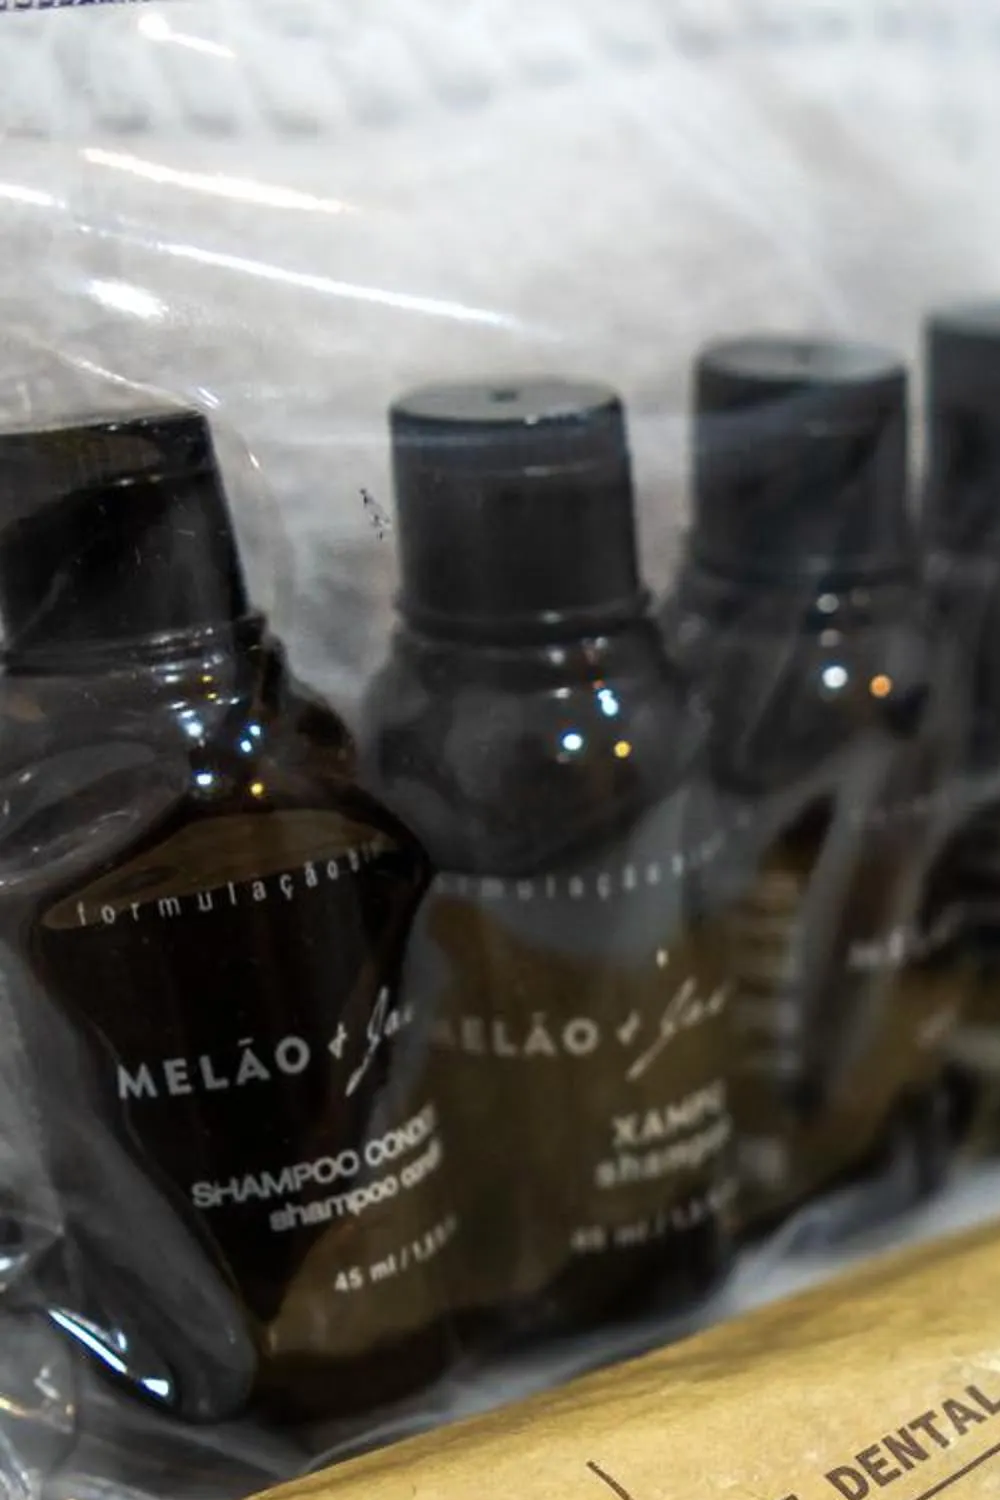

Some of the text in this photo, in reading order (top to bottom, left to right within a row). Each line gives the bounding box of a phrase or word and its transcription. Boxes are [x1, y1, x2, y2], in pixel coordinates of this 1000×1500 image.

[116, 1036, 311, 1100] MELÃO
[191, 1149, 361, 1208] SHAMPOO
[269, 1175, 399, 1233] shampoo
[334, 1265, 363, 1291] 45
[370, 1253, 398, 1282] ml
